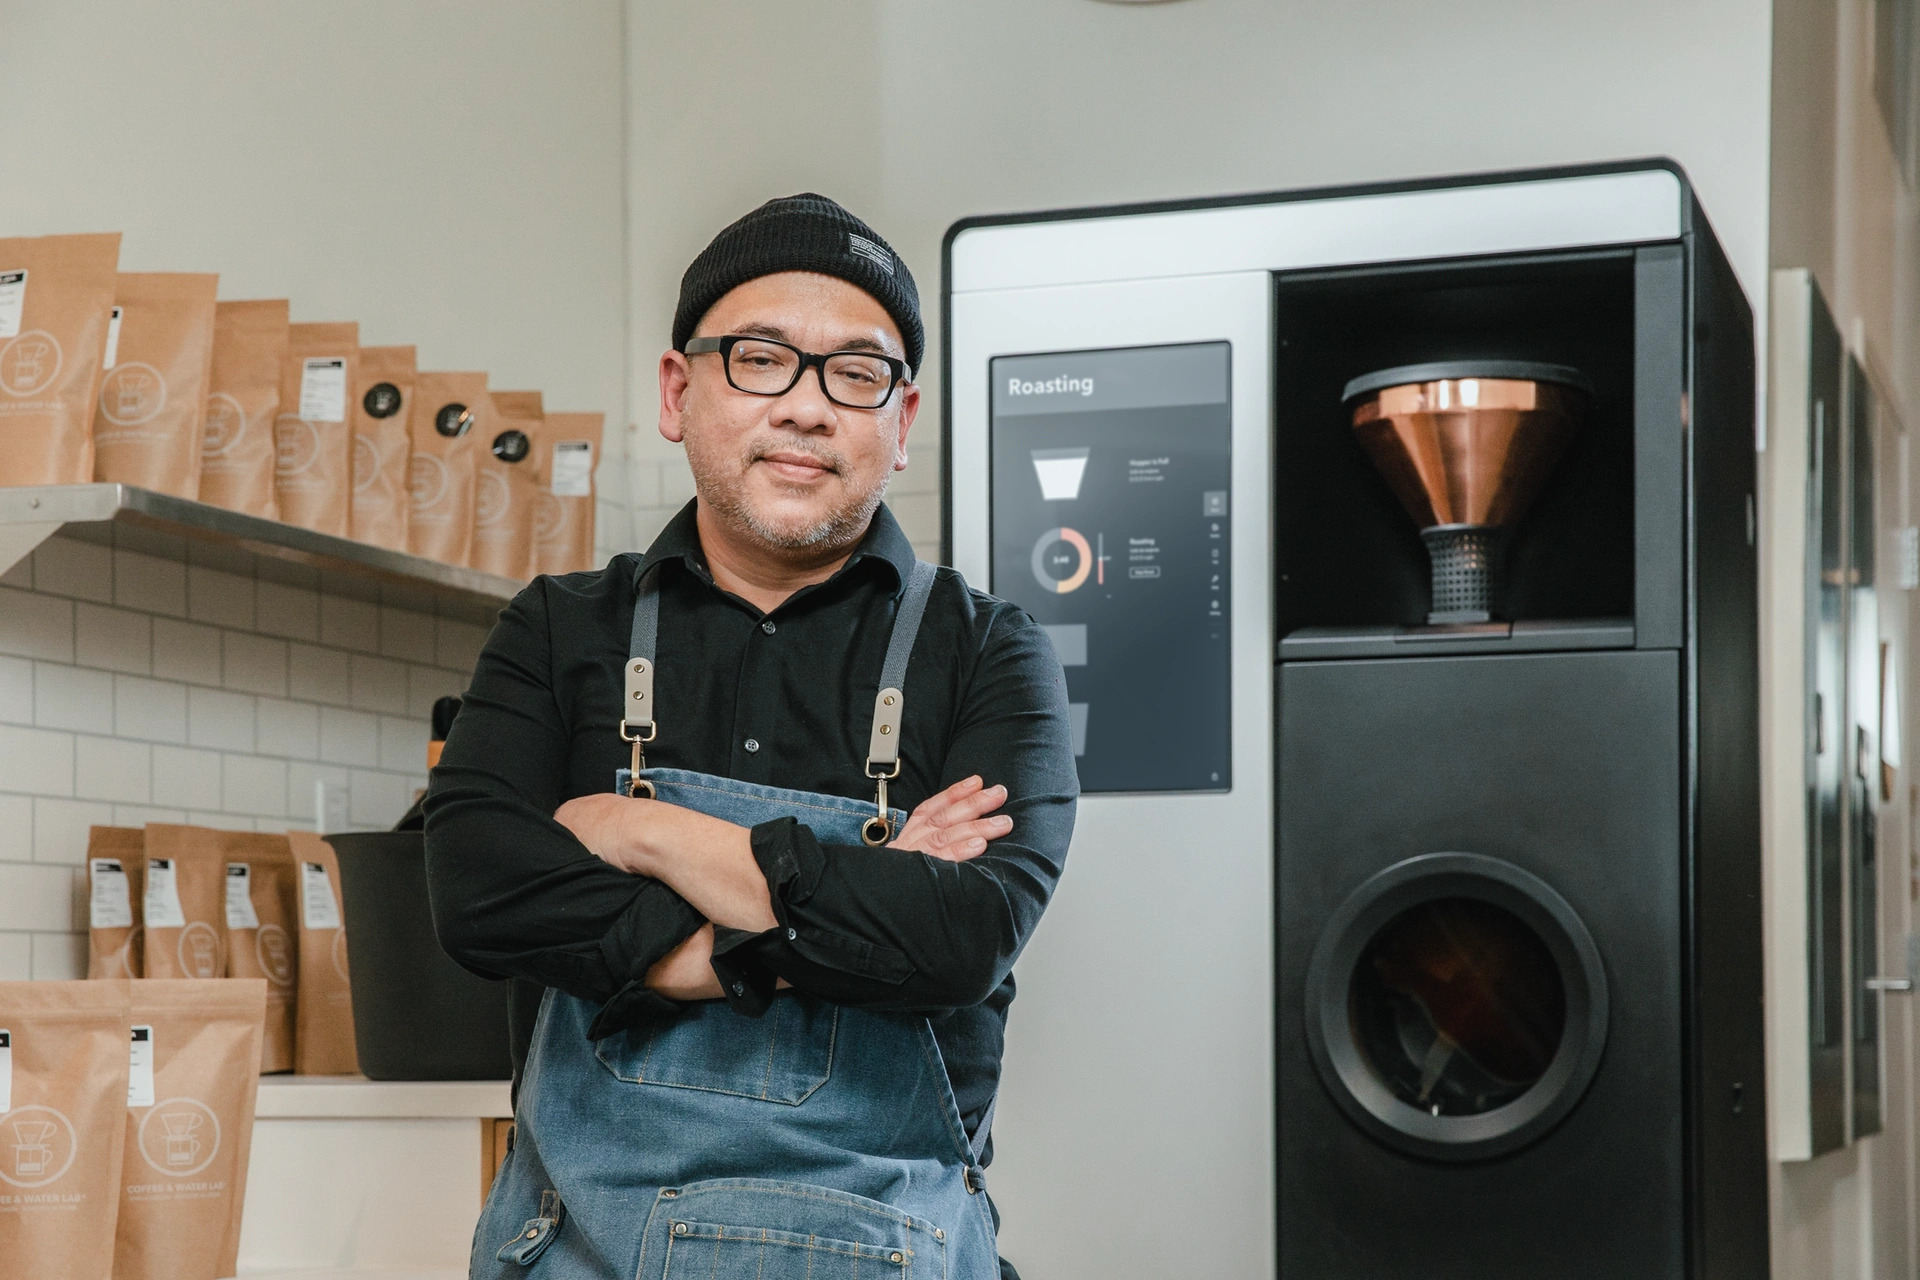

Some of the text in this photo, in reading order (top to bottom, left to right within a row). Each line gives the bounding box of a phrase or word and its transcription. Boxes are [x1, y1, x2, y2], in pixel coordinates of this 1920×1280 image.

[1008, 374, 1094, 396] Roasting
[127, 1184, 164, 1194] COFFEE
[175, 1182, 208, 1192] WATER
[14, 1194, 21, 1203] &
[23, 1193, 59, 1203] WATER
